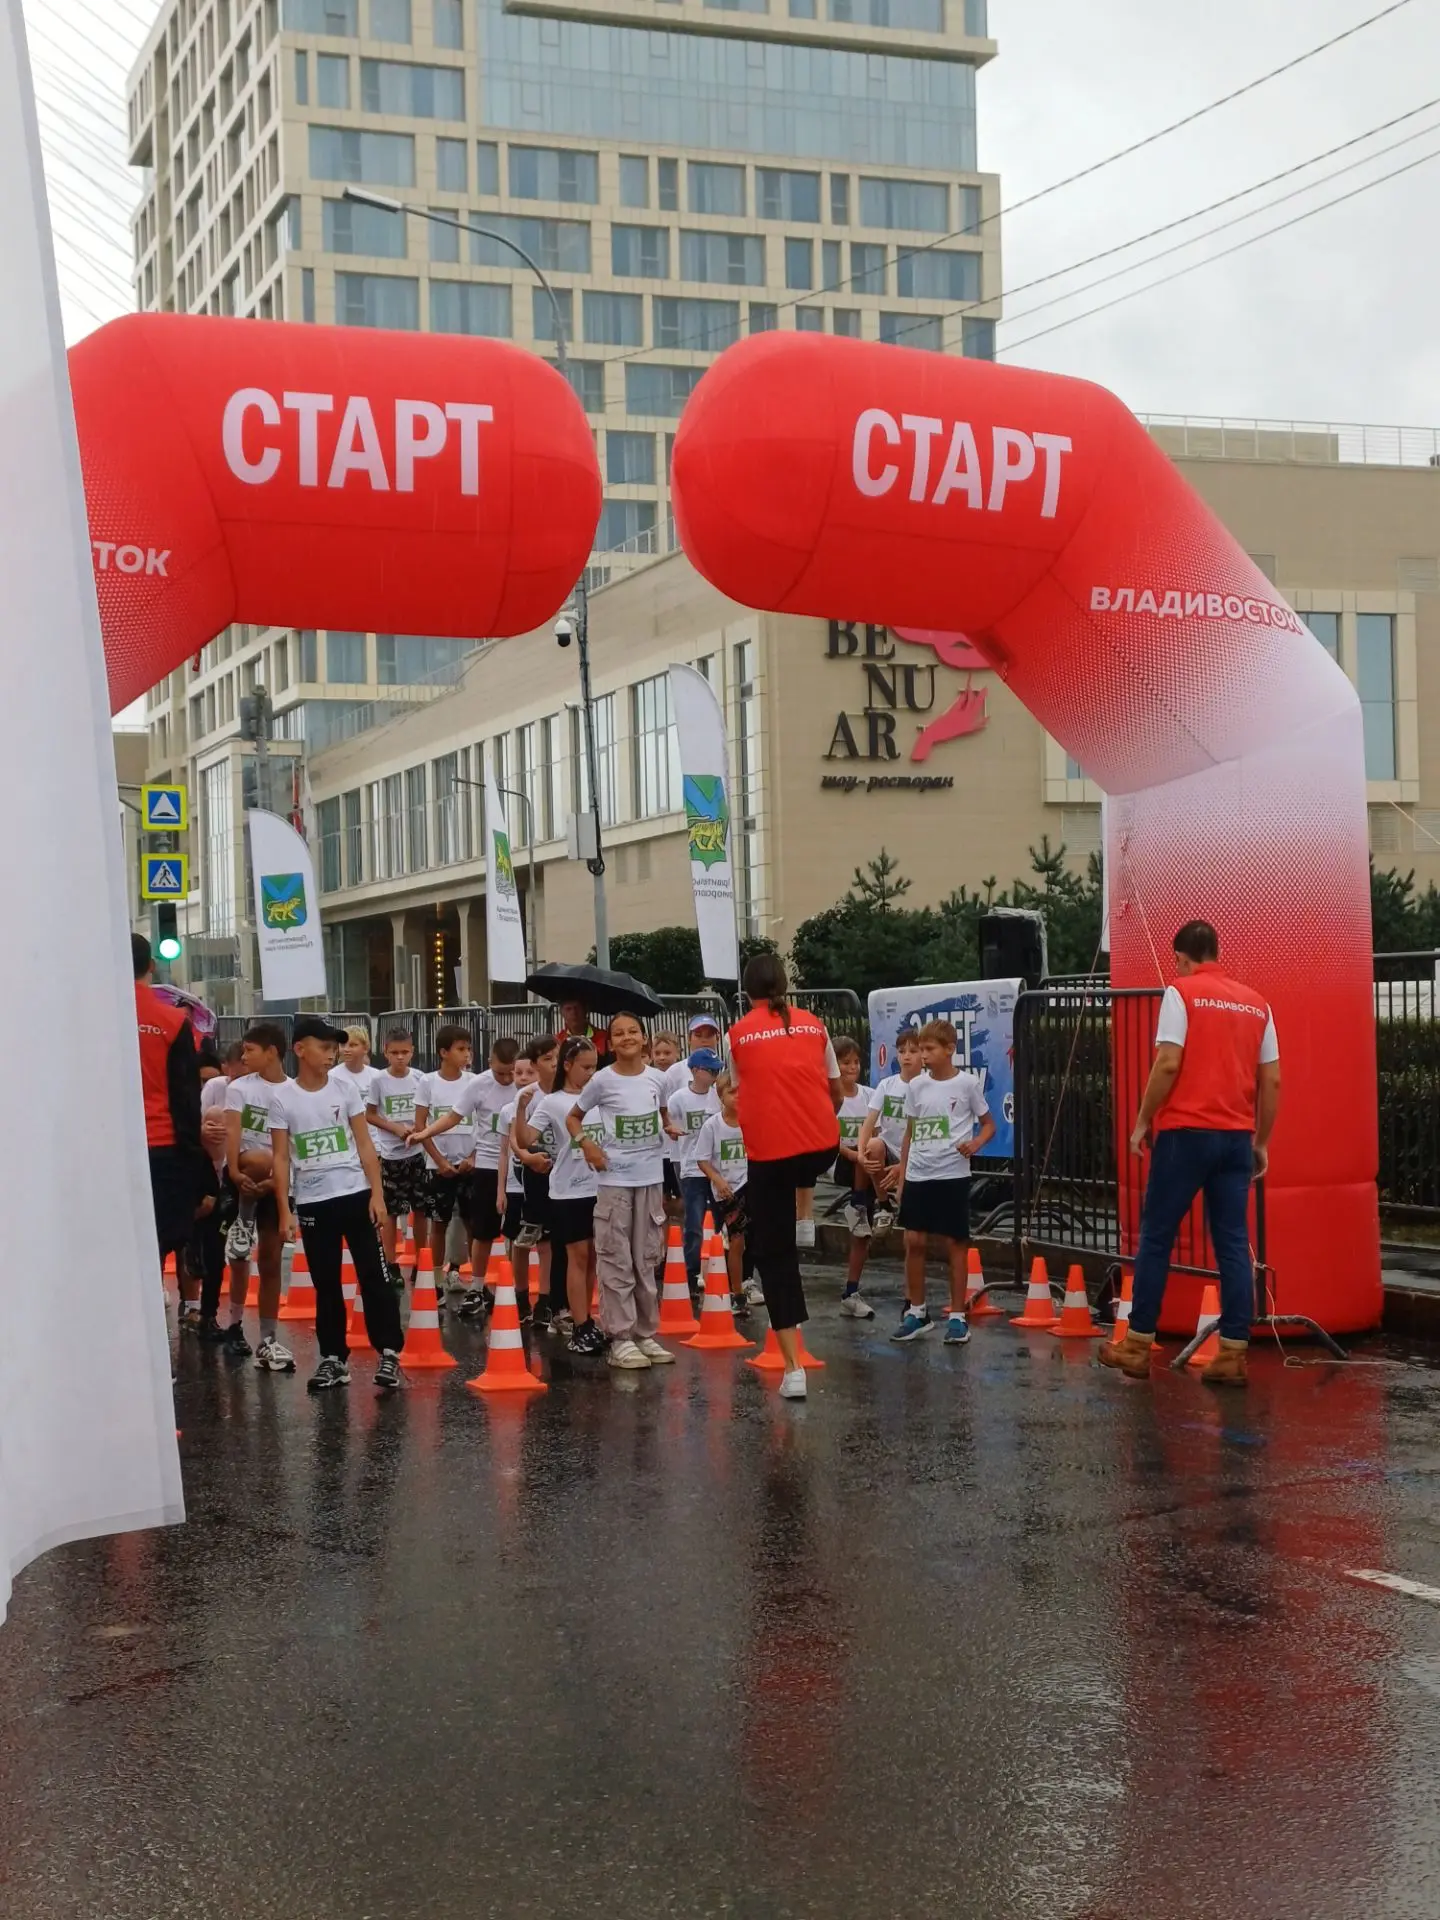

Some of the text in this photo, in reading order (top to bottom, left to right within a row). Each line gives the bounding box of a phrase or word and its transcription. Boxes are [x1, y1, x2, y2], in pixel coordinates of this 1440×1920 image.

[222, 387, 494, 496] СТАРТ
[852, 407, 1073, 518] СТАРТ
[1090, 586, 1304, 635] ВЛАДИВОСТОК
[824, 619, 896, 659] BE
[862, 663, 939, 712] NU
[822, 711, 901, 761] AR
[305, 1133, 339, 1157] 521
[622, 1118, 654, 1139] 535
[914, 1120, 943, 1140] 524
